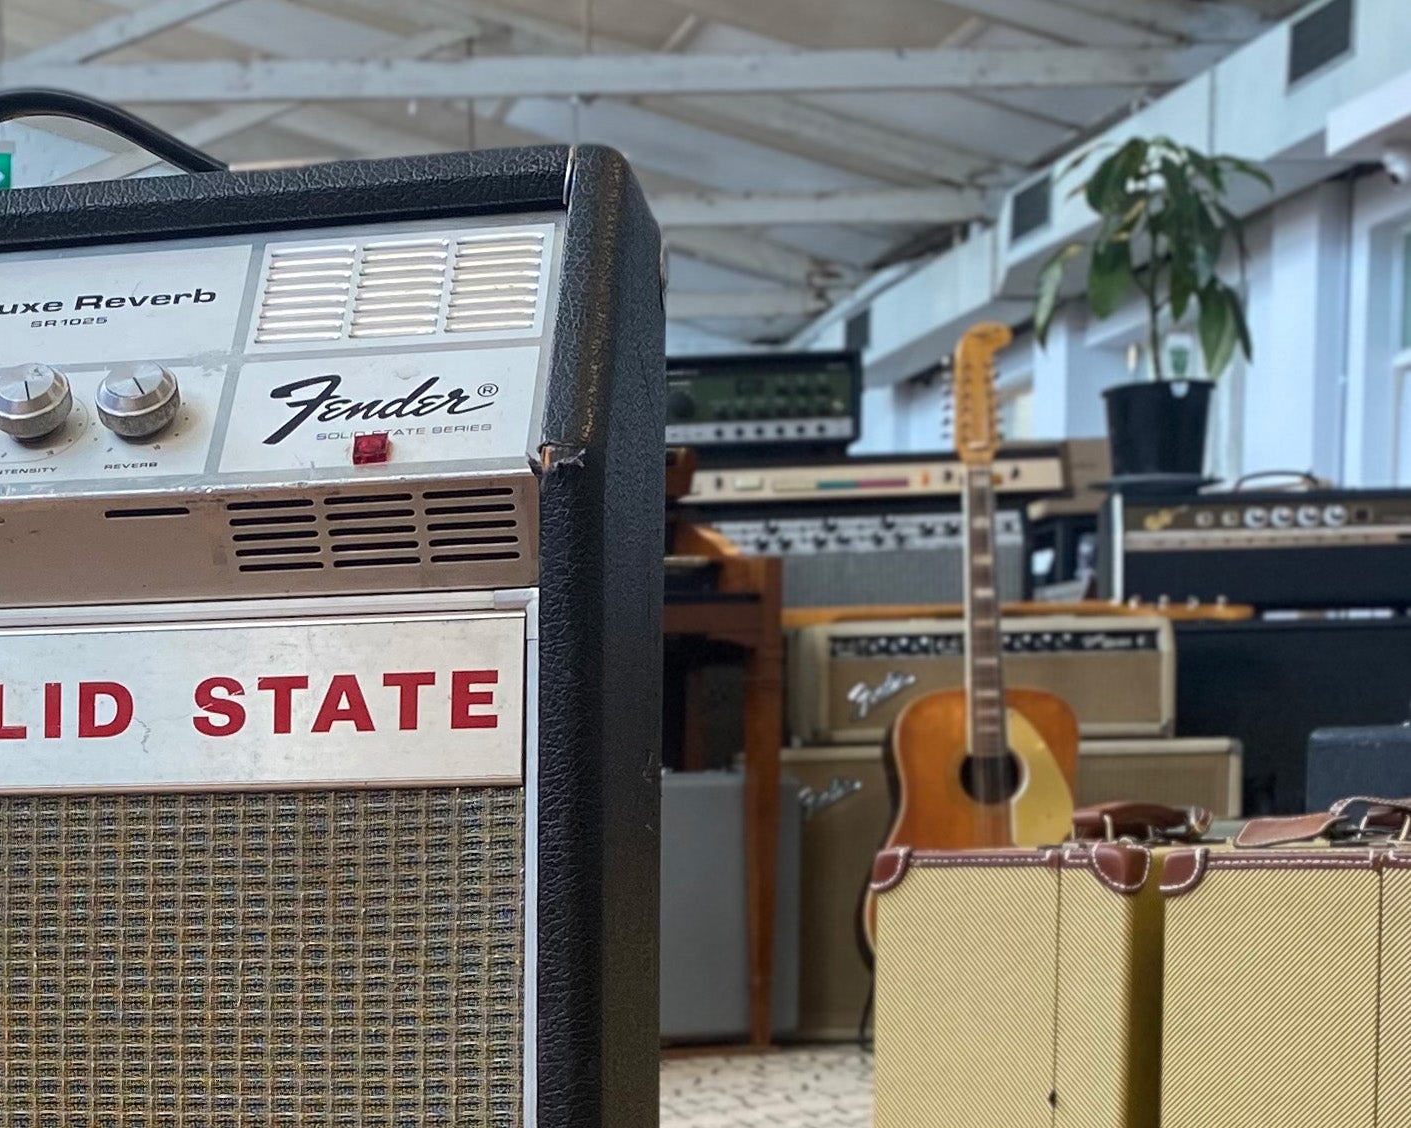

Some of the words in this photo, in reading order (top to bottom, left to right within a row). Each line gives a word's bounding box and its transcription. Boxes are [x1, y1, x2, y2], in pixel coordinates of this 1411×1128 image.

[74, 288, 217, 311] Reverb
[30, 316, 108, 328] SR1025
[262, 374, 494, 445] Fender
[432, 423, 492, 434] SERIES
[104, 461, 158, 470] REVERB
[192, 669, 500, 738] STATE
